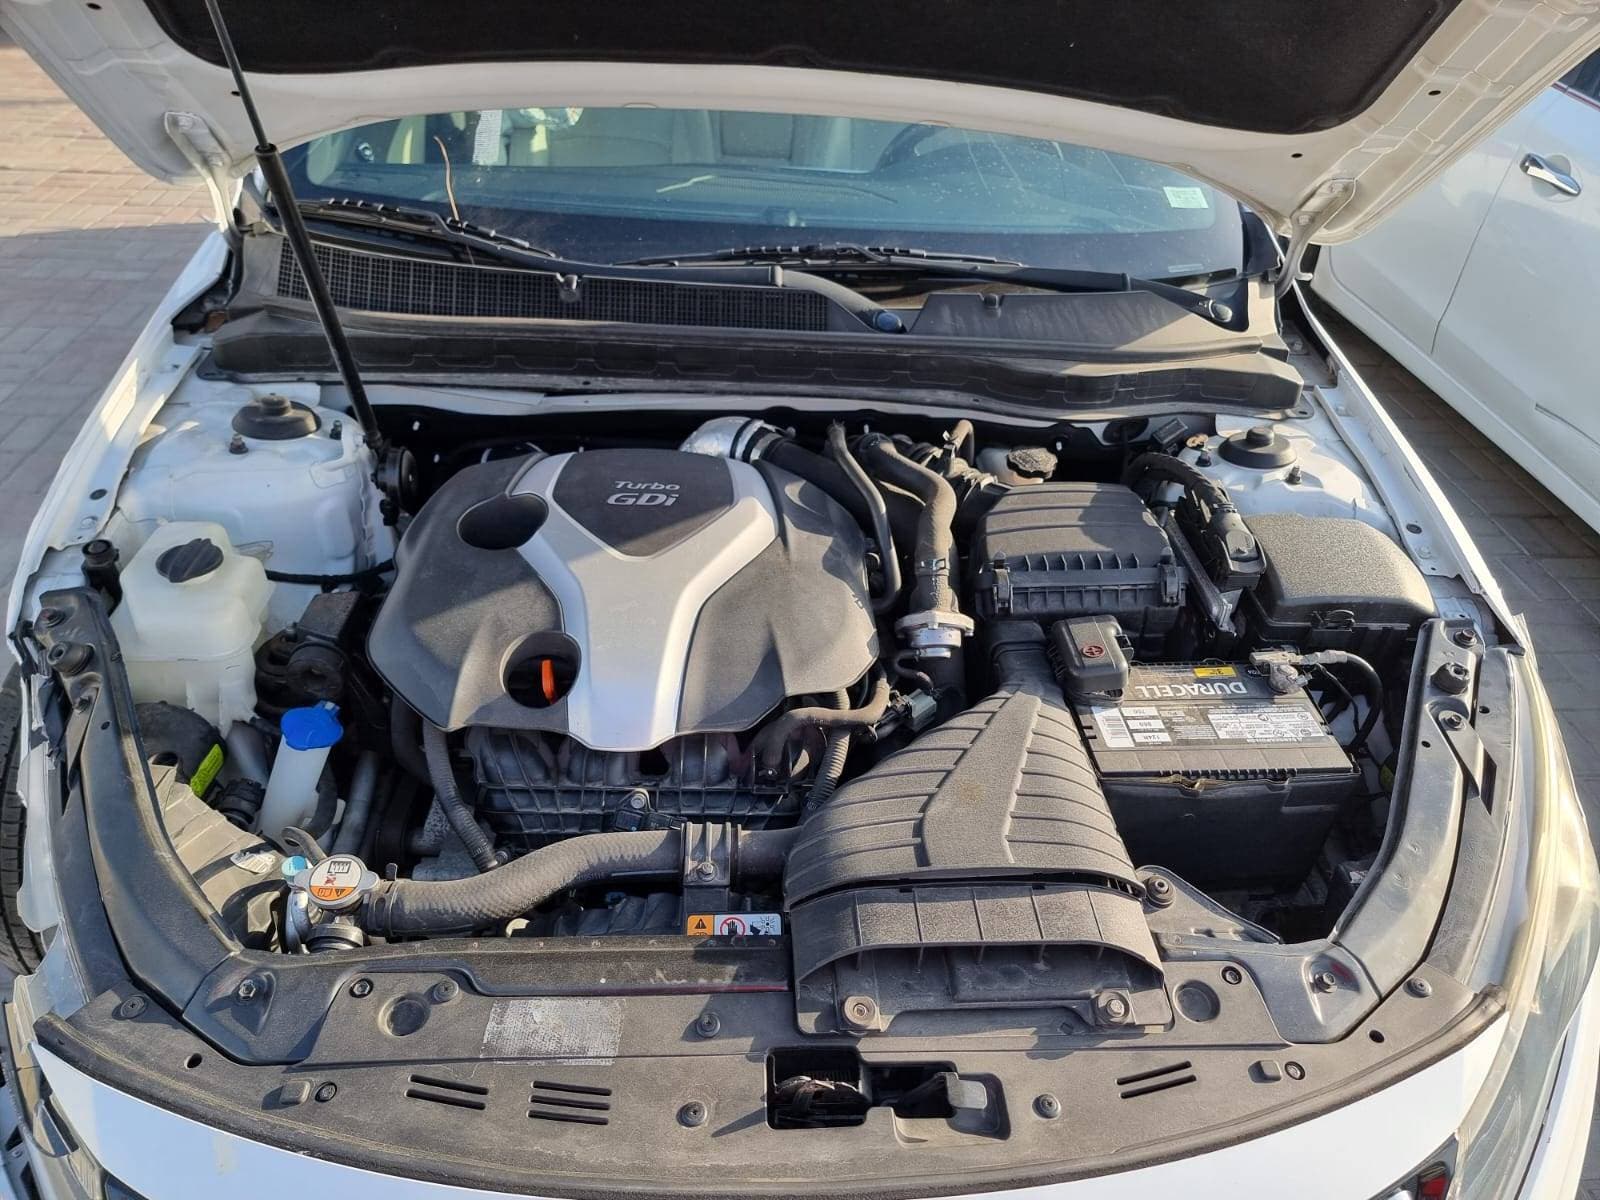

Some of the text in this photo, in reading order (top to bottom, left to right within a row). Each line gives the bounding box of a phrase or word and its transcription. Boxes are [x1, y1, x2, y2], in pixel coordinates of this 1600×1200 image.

[615, 481, 680, 490] Turbo
[607, 493, 679, 506] GDi
[1135, 682, 1248, 698] DURACELL
